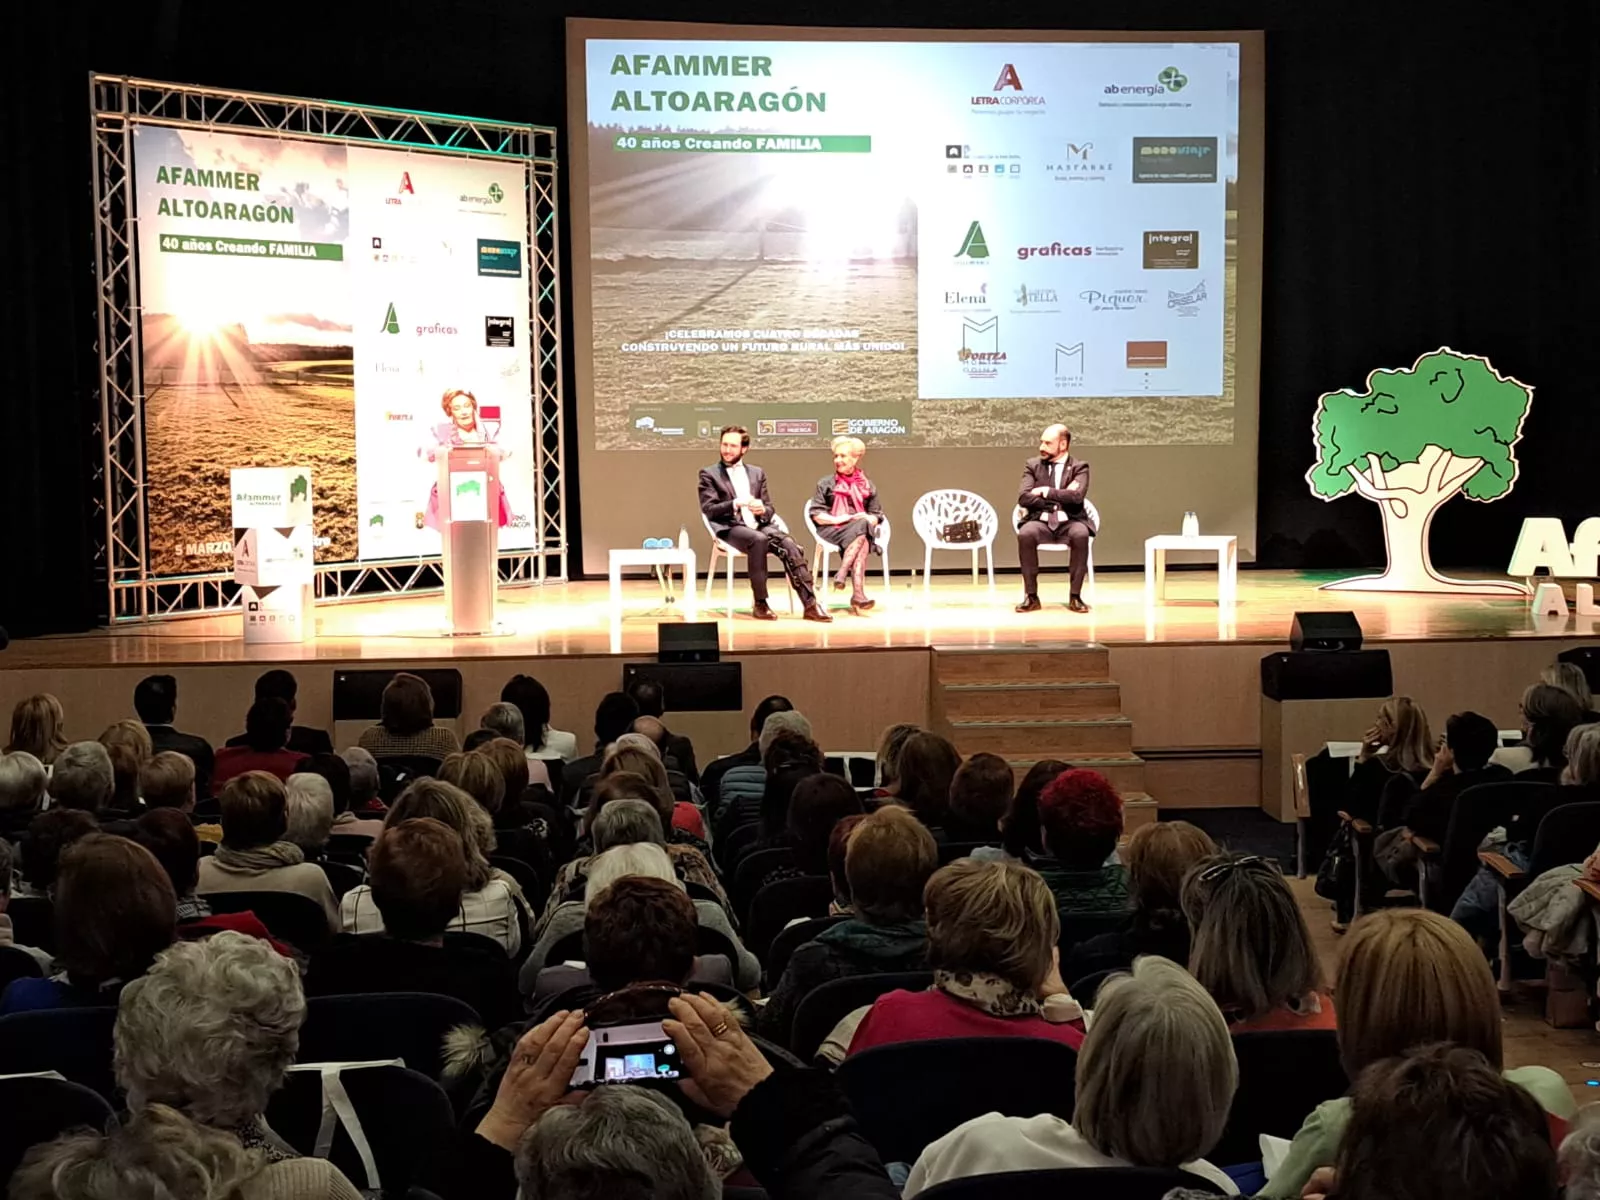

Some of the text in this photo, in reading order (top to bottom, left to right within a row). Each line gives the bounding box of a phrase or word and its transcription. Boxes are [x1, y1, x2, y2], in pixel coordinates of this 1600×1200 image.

[610, 54, 772, 77] AFAMMER
[611, 86, 827, 112] ALTOARAGÓN
[616, 137, 822, 151] 40 años Creando FAMILIA
[156, 165, 260, 192] AFAMMER
[157, 197, 294, 224] ALTOARAGÓN
[162, 237, 317, 257] 40 años Creando FAMILIA
[943, 291, 986, 304] Elena
[621, 342, 719, 352] CONSTRUYENDO
[722, 343, 739, 352] UN
[742, 342, 788, 352] FUTURO
[791, 342, 832, 351] RURAL
[175, 541, 232, 556] 5 MARZO
